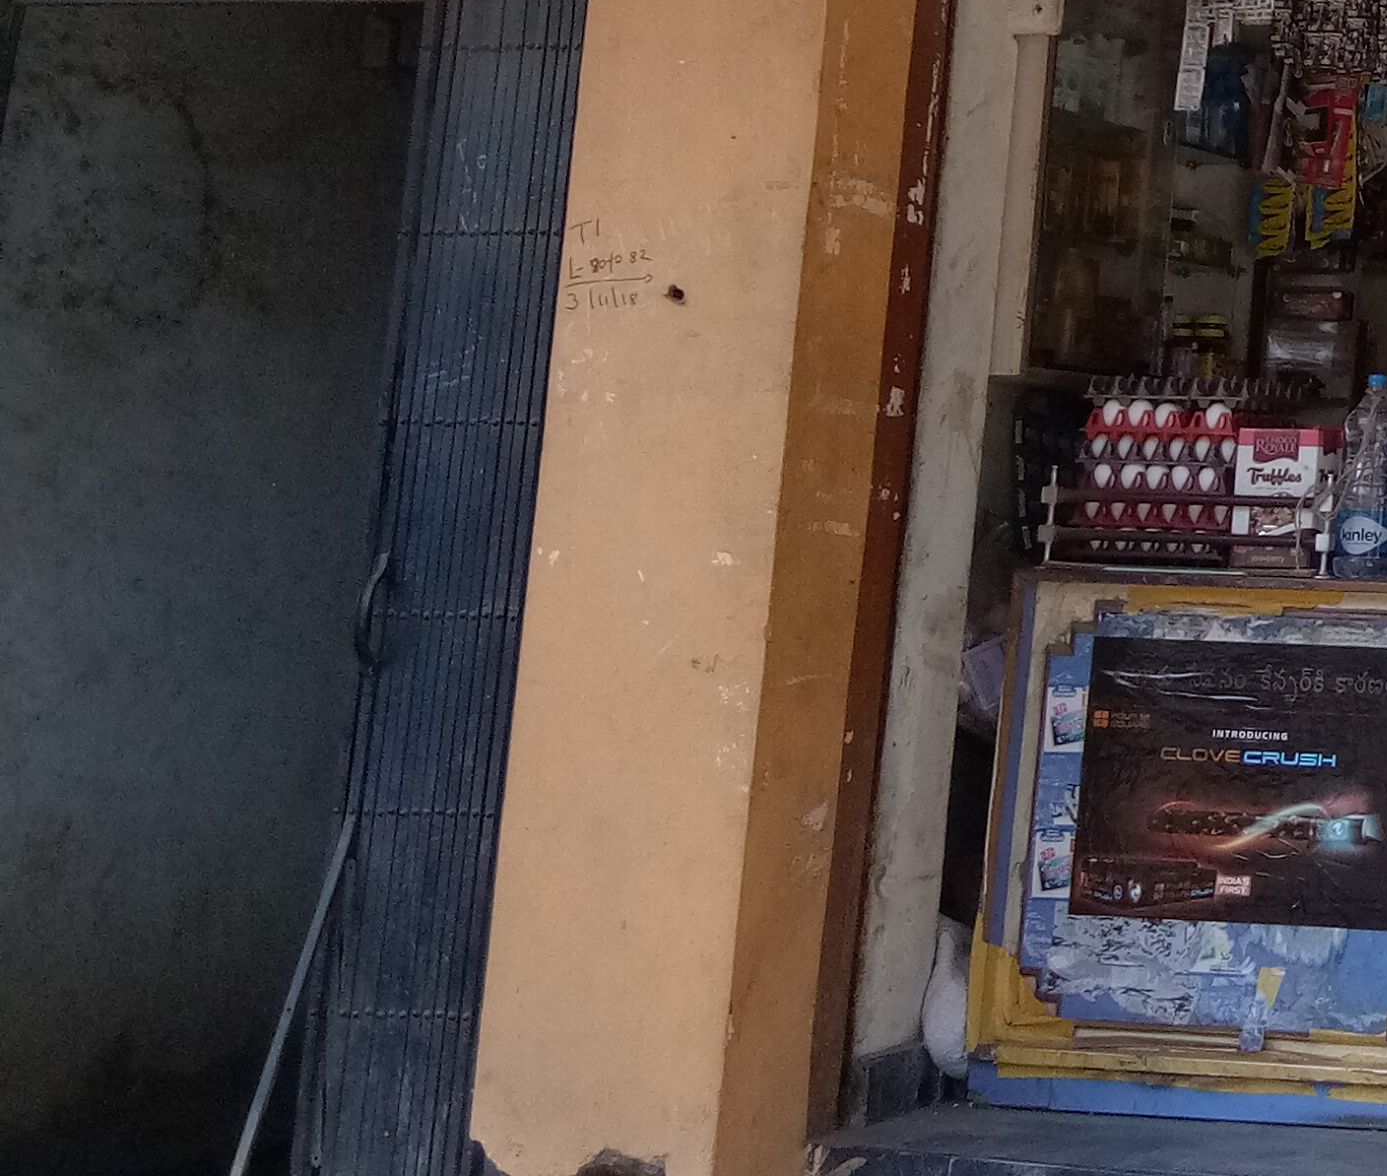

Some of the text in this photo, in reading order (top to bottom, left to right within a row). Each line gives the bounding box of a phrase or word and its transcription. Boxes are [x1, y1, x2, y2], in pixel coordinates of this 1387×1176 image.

[1255, 438, 1298, 456] ROYALE
[1247, 466, 1303, 486] Truffles
[1341, 526, 1383, 544] kinley
[1211, 728, 1289, 742] INTRODUCING
